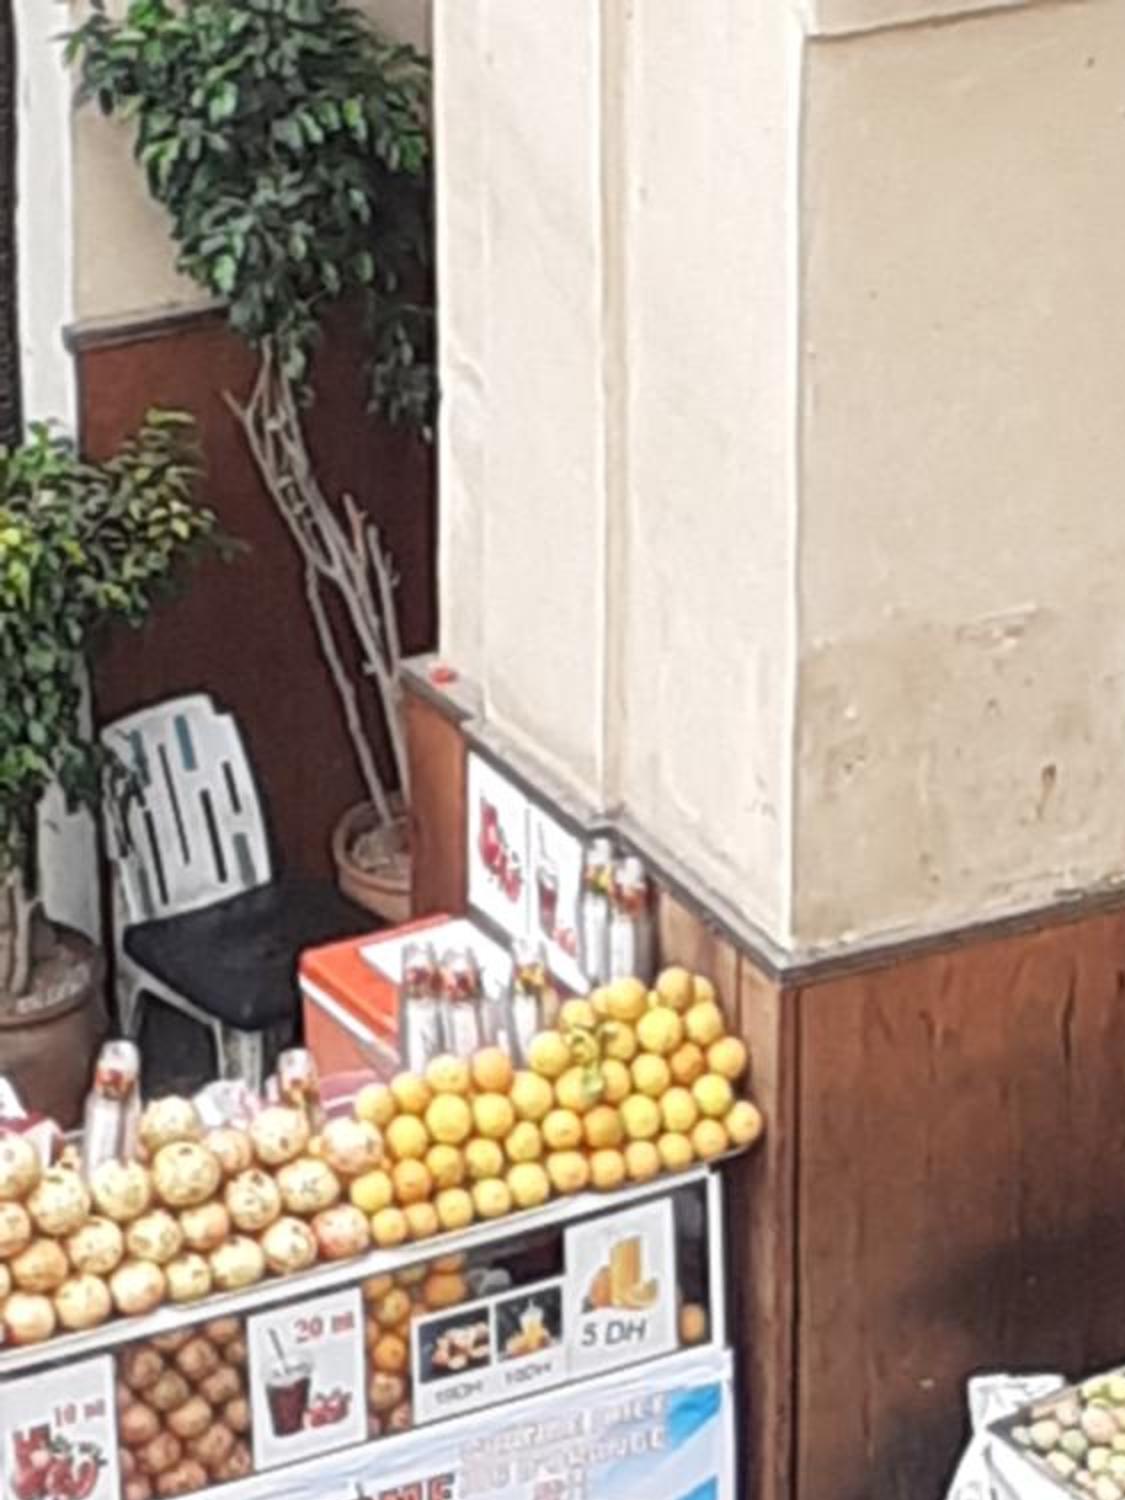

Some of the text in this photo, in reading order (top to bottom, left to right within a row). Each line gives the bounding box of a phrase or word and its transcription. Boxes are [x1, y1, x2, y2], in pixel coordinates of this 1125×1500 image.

[293, 1316, 323, 1343] 20
[581, 1318, 648, 1347] 5 DH
